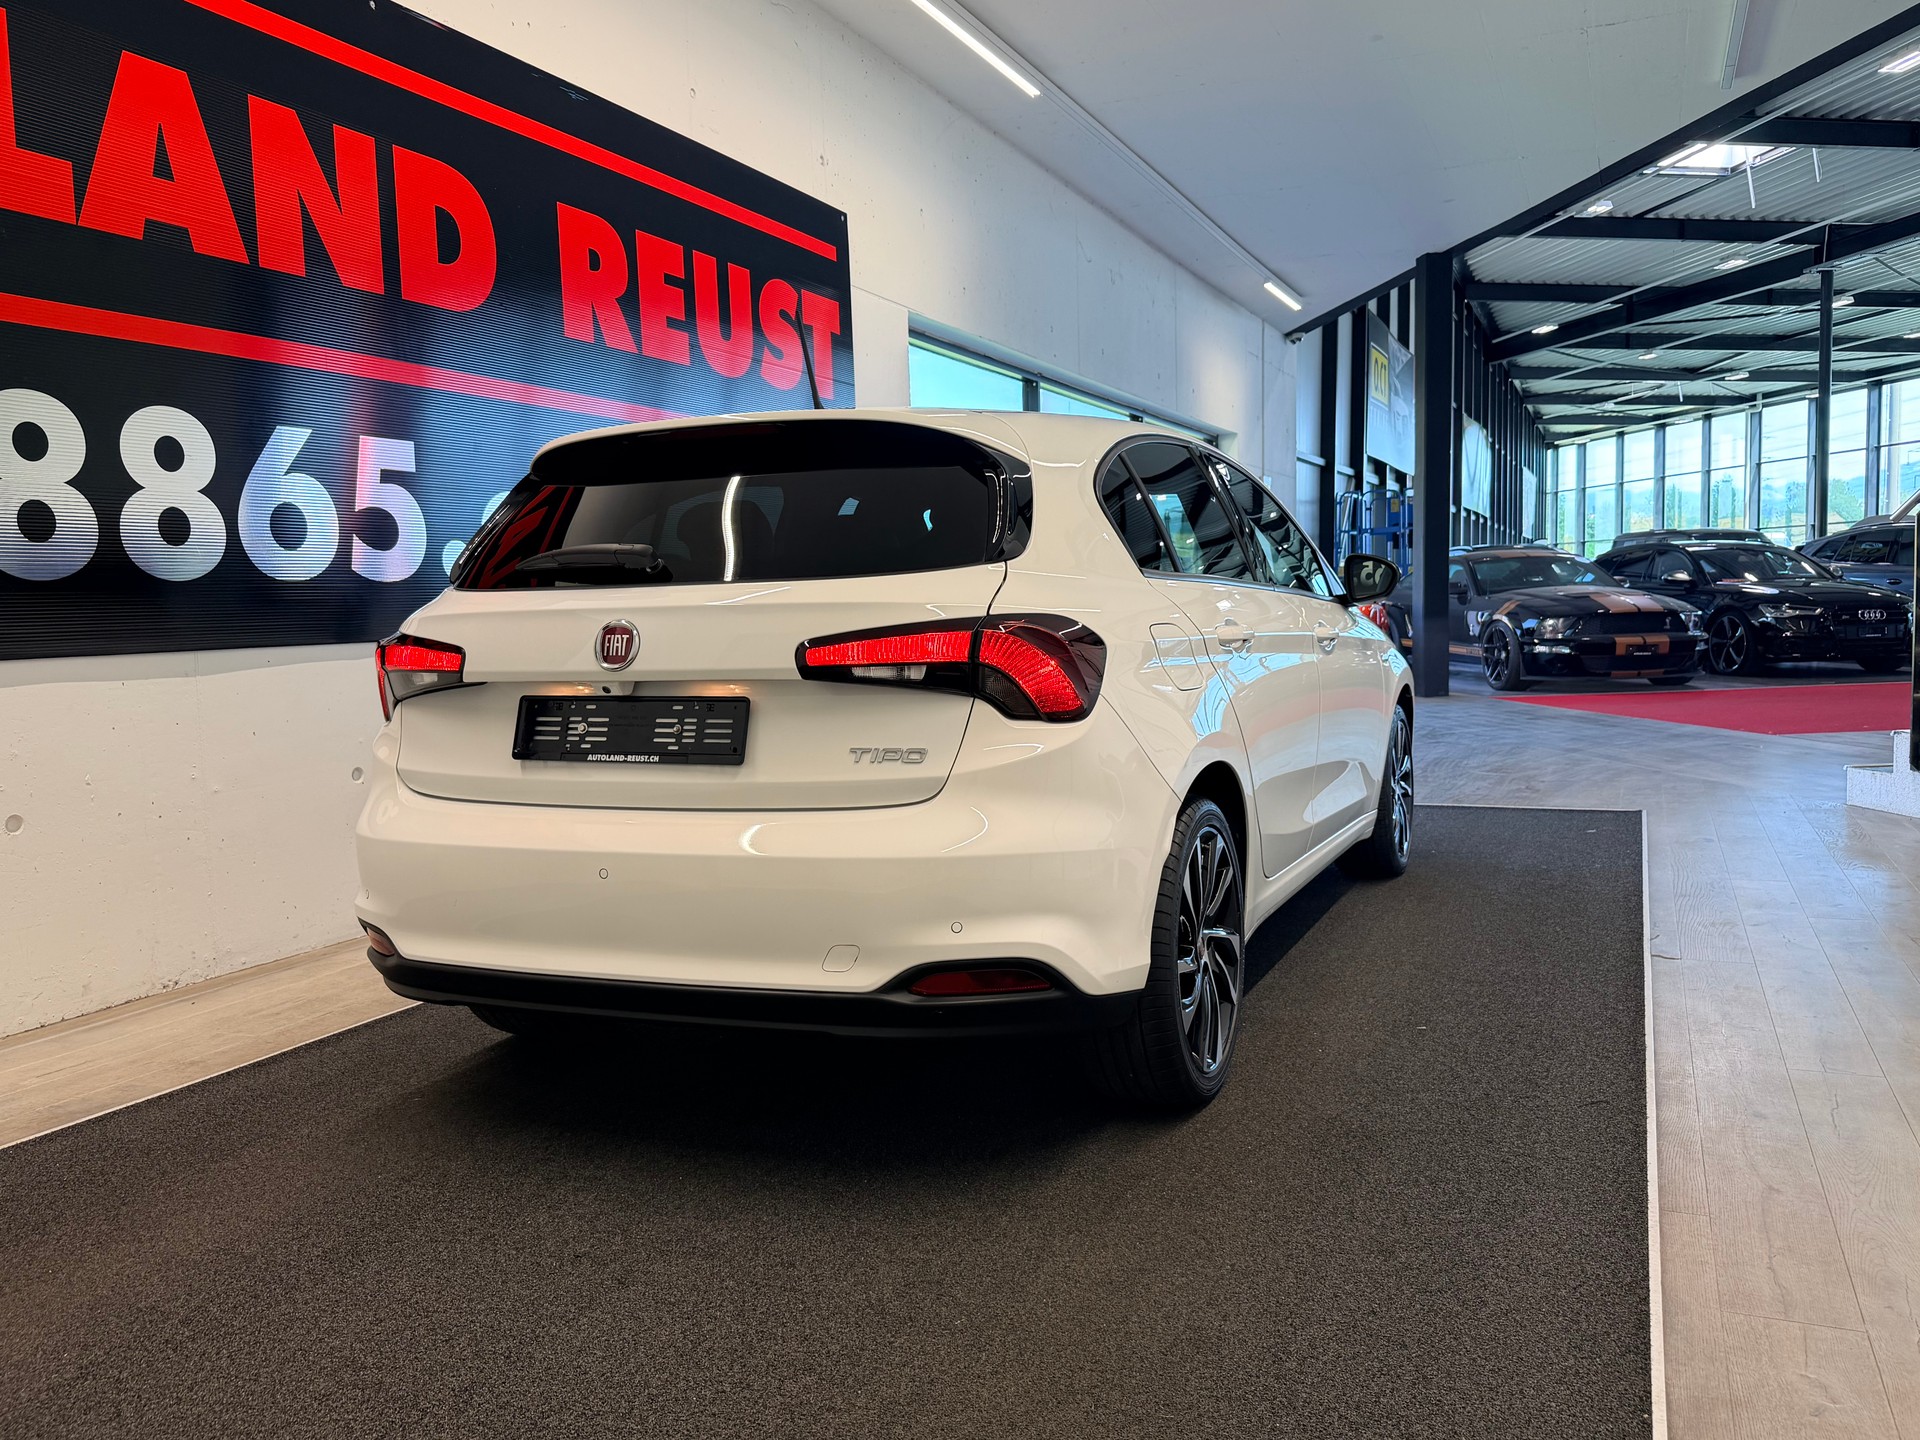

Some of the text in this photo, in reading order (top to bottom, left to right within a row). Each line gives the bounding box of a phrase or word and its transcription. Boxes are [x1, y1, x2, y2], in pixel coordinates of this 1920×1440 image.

[556, 201, 841, 400] REUST
[603, 634, 630, 656] FIAT
[587, 754, 659, 762] AUTOLAND-REUST.CH
[849, 747, 928, 764] TIPO
